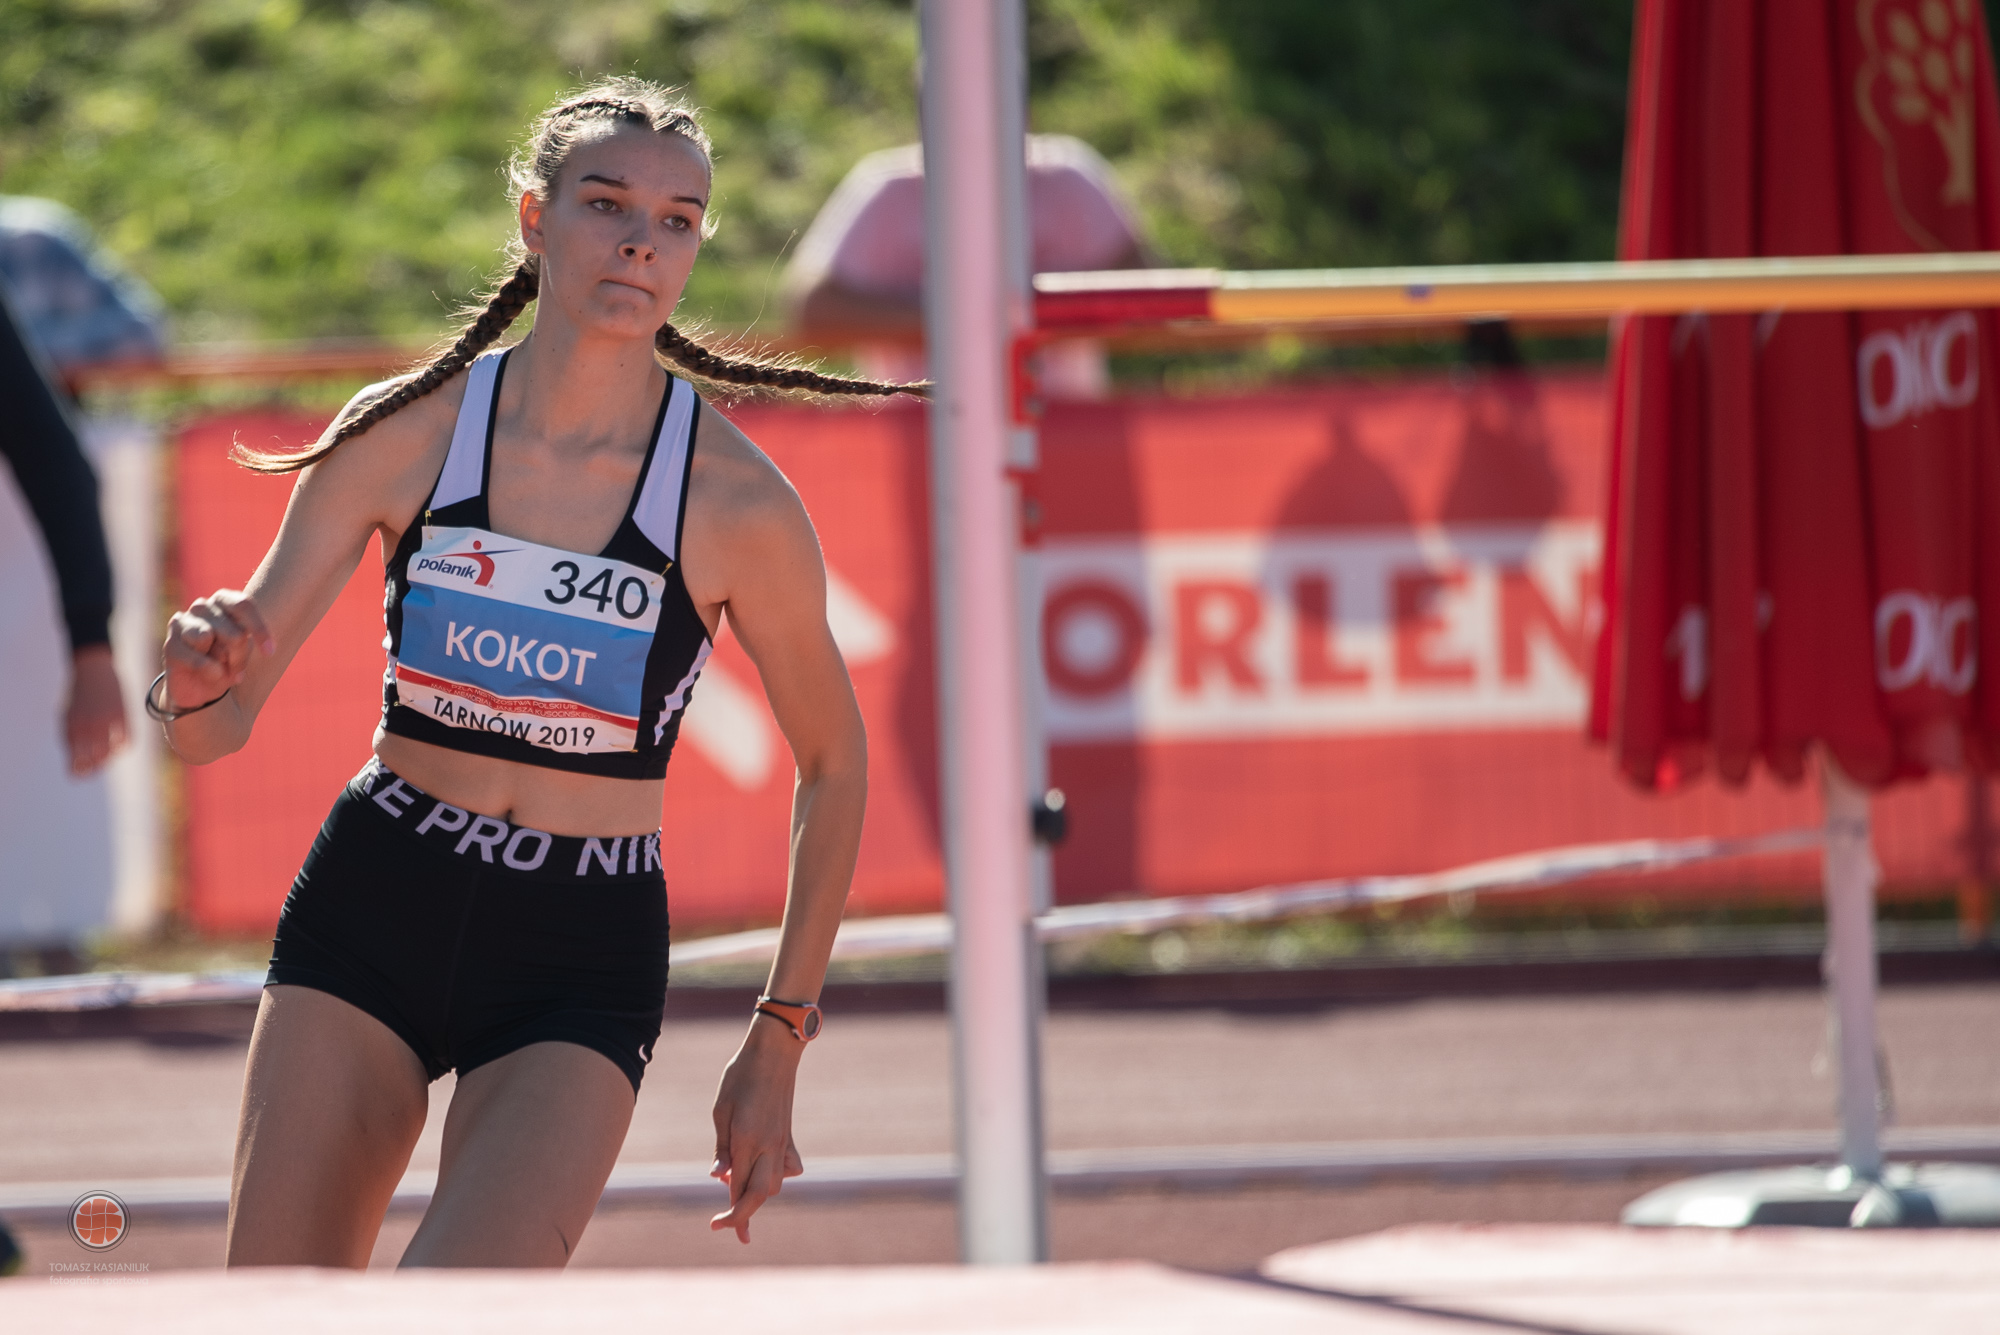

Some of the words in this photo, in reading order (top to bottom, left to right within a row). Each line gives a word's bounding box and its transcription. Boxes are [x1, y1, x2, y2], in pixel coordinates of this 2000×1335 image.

[416, 558, 477, 580] polanik
[544, 560, 649, 620] 340
[445, 621, 598, 686] KOKOT
[1040, 566, 1602, 701] ORLEN
[434, 695, 532, 740] TARNÓW
[537, 726, 595, 747] 2019
[495, 704, 533, 714] JANUSZA
[533, 701, 562, 710] POLSKI
[415, 801, 552, 872] PRO
